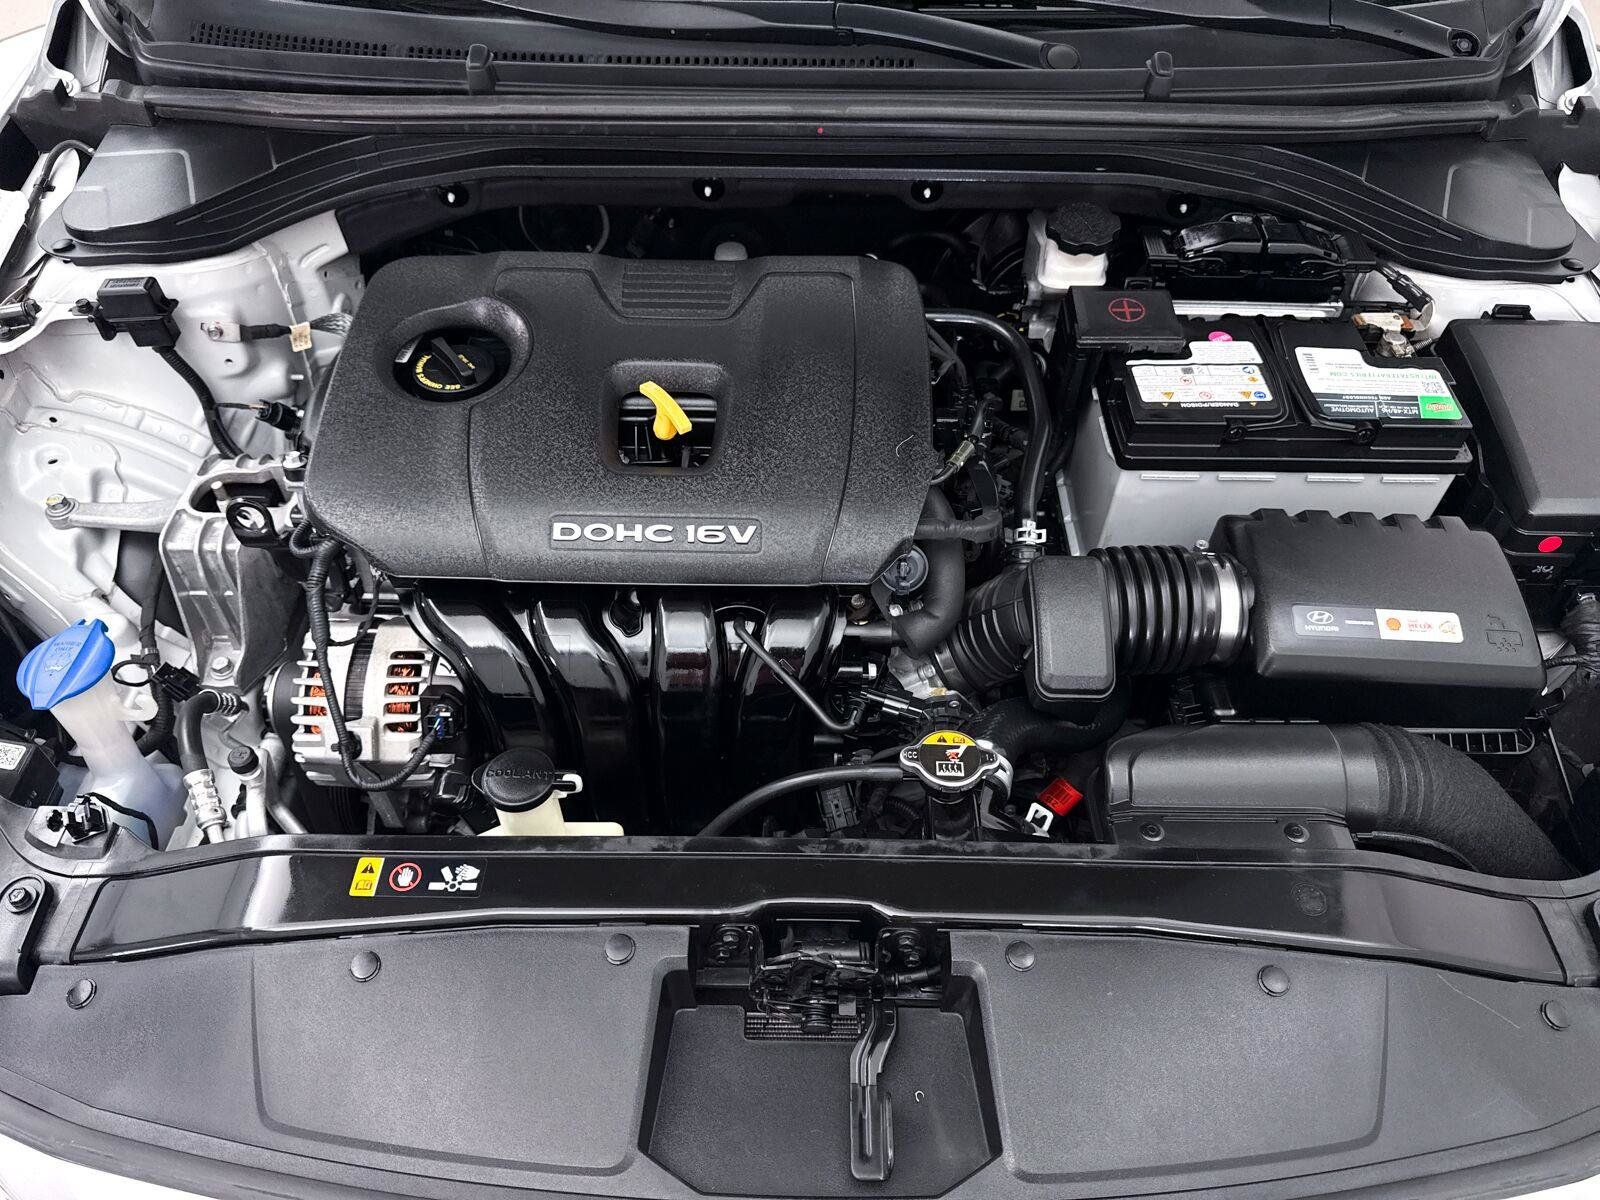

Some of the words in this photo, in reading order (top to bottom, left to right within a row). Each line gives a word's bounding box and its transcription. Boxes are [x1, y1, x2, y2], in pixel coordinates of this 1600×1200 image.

[1330, 406, 1375, 414] AUTOMOTIVE
[553, 522, 674, 543] DOHC
[686, 524, 757, 544] 16V
[1304, 624, 1340, 632] HYUNDAI
[486, 768, 553, 780] COOLANT
